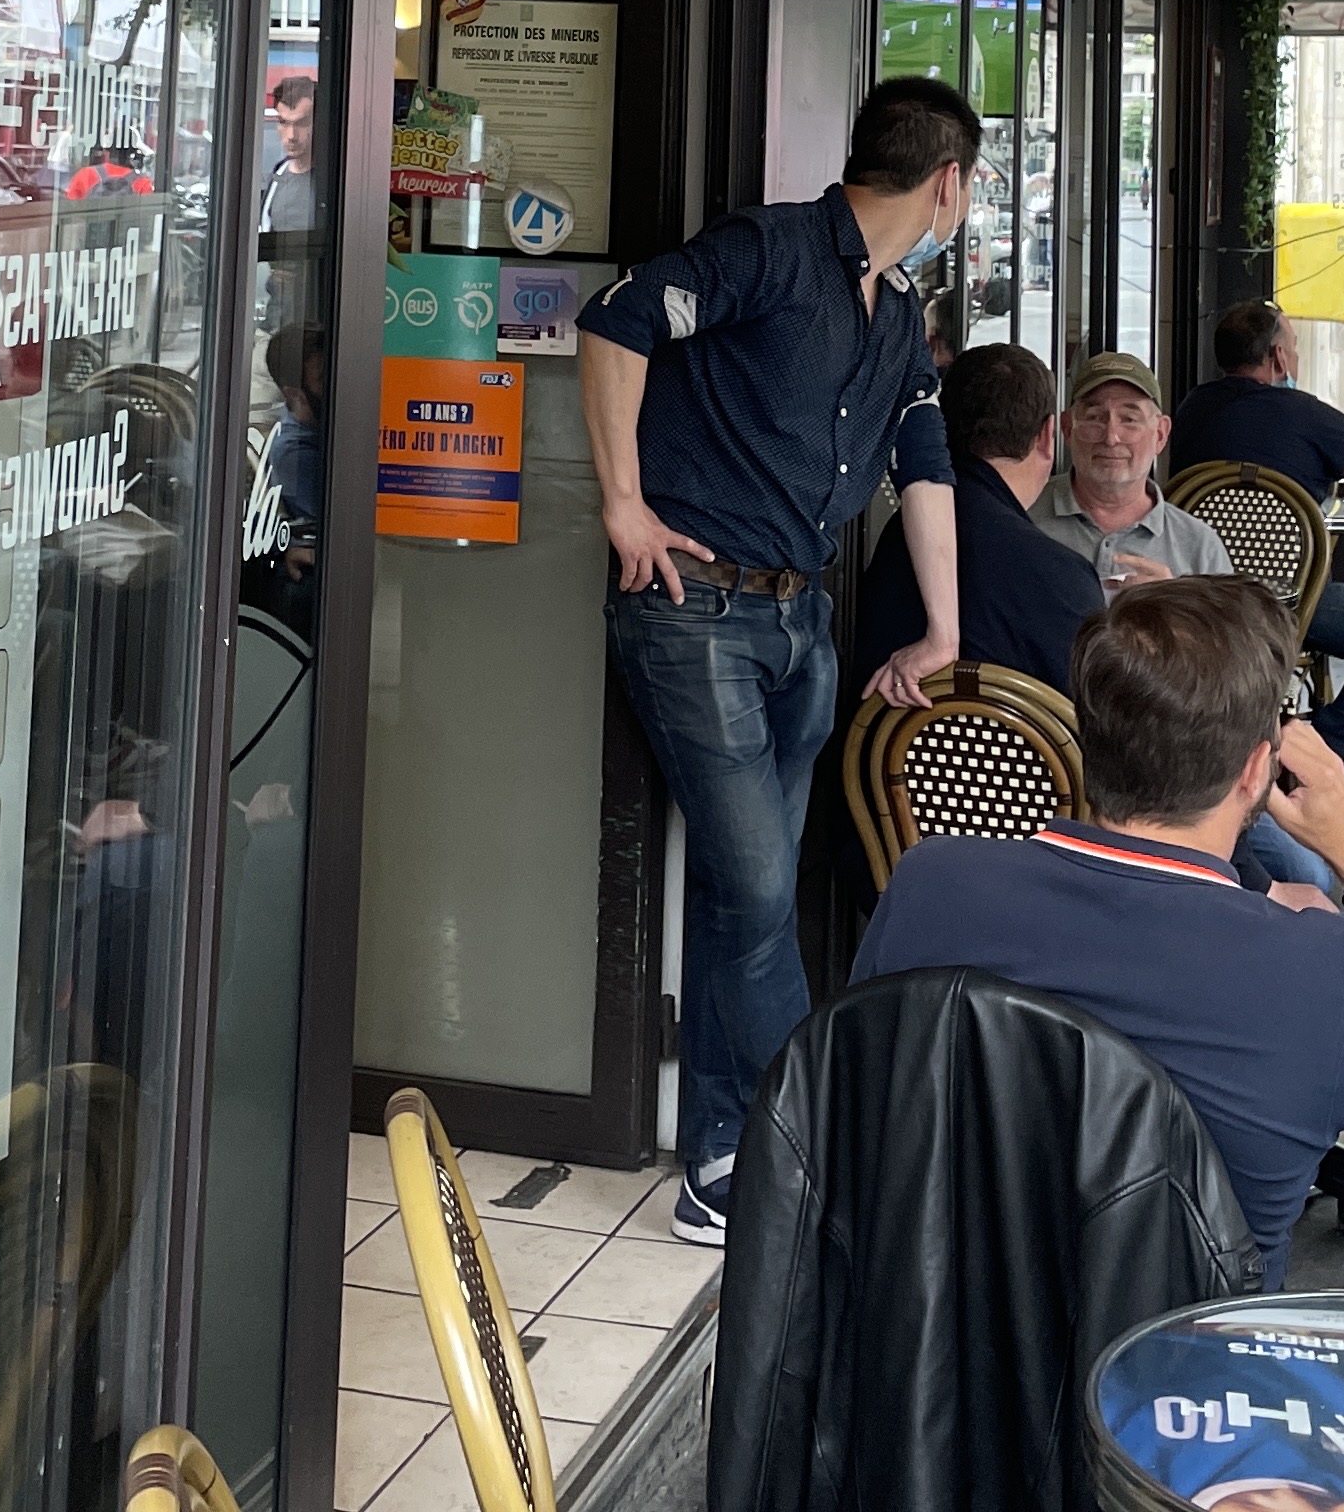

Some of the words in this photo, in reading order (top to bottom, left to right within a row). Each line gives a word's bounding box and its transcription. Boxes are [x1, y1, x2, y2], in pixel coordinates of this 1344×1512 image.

[453, 24, 519, 40] PROTECTION
[525, 27, 545, 40] DES
[551, 28, 600, 43] MINEURS
[503, 49, 514, 62] DE
[559, 52, 599, 66] PUBLIQUE
[398, 172, 458, 196] heureux
[407, 299, 434, 315] BUS
[480, 374, 500, 385] FDJ
[434, 404, 458, 422] ANS
[411, 430, 435, 453] JEU
[440, 433, 505, 457] D'ARGENT
[1226, 1340, 1332, 1364] PRÊTS
